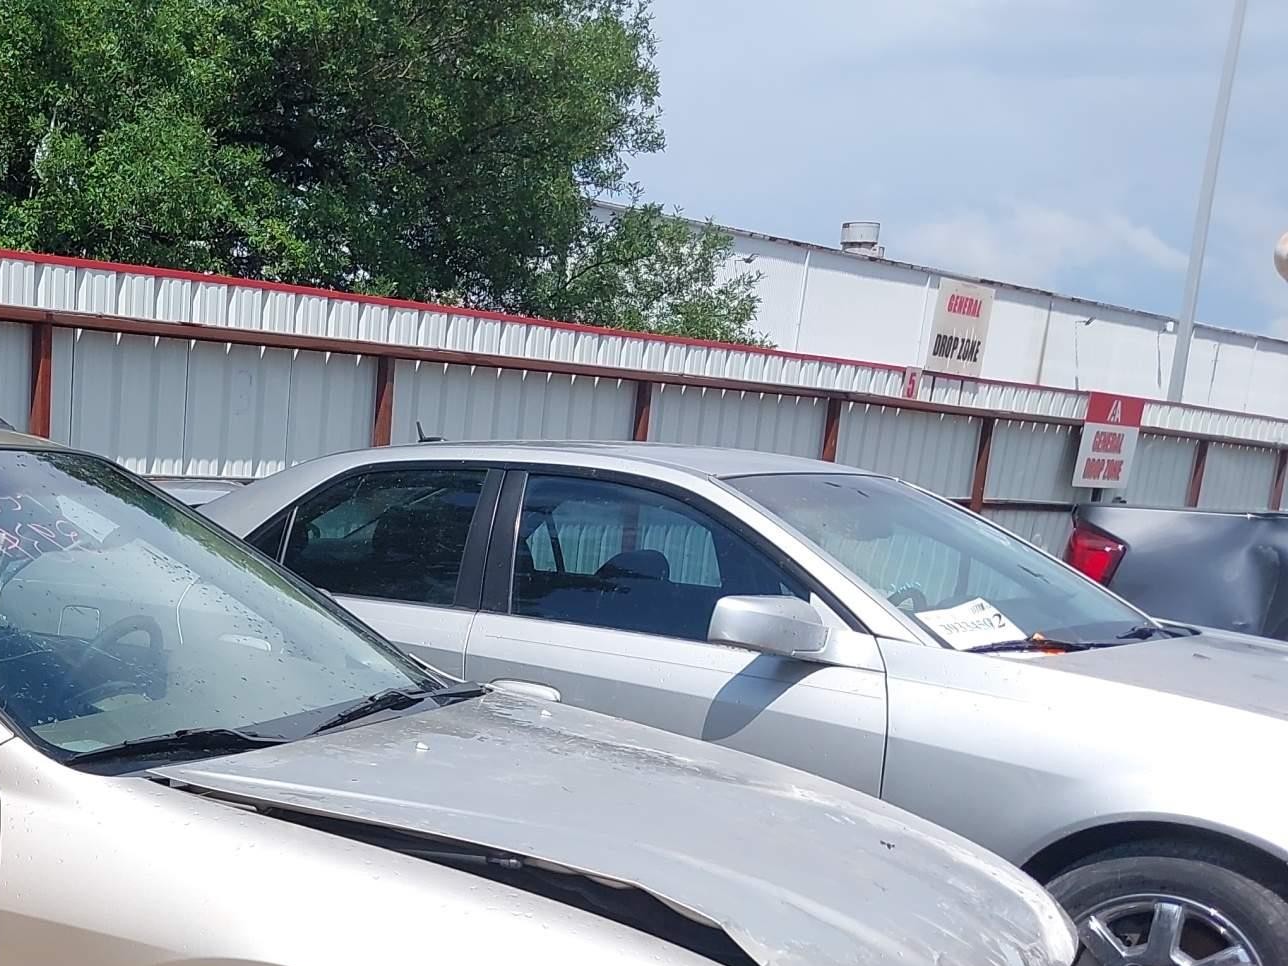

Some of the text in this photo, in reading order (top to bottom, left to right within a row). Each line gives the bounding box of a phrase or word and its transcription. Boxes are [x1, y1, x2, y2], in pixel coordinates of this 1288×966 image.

[947, 295, 982, 317] GENERAL
[932, 334, 981, 362] DROP ZONE
[907, 372, 916, 398] 5
[1092, 430, 1124, 454] GENERAL
[1082, 457, 1124, 481] DROP ZONE
